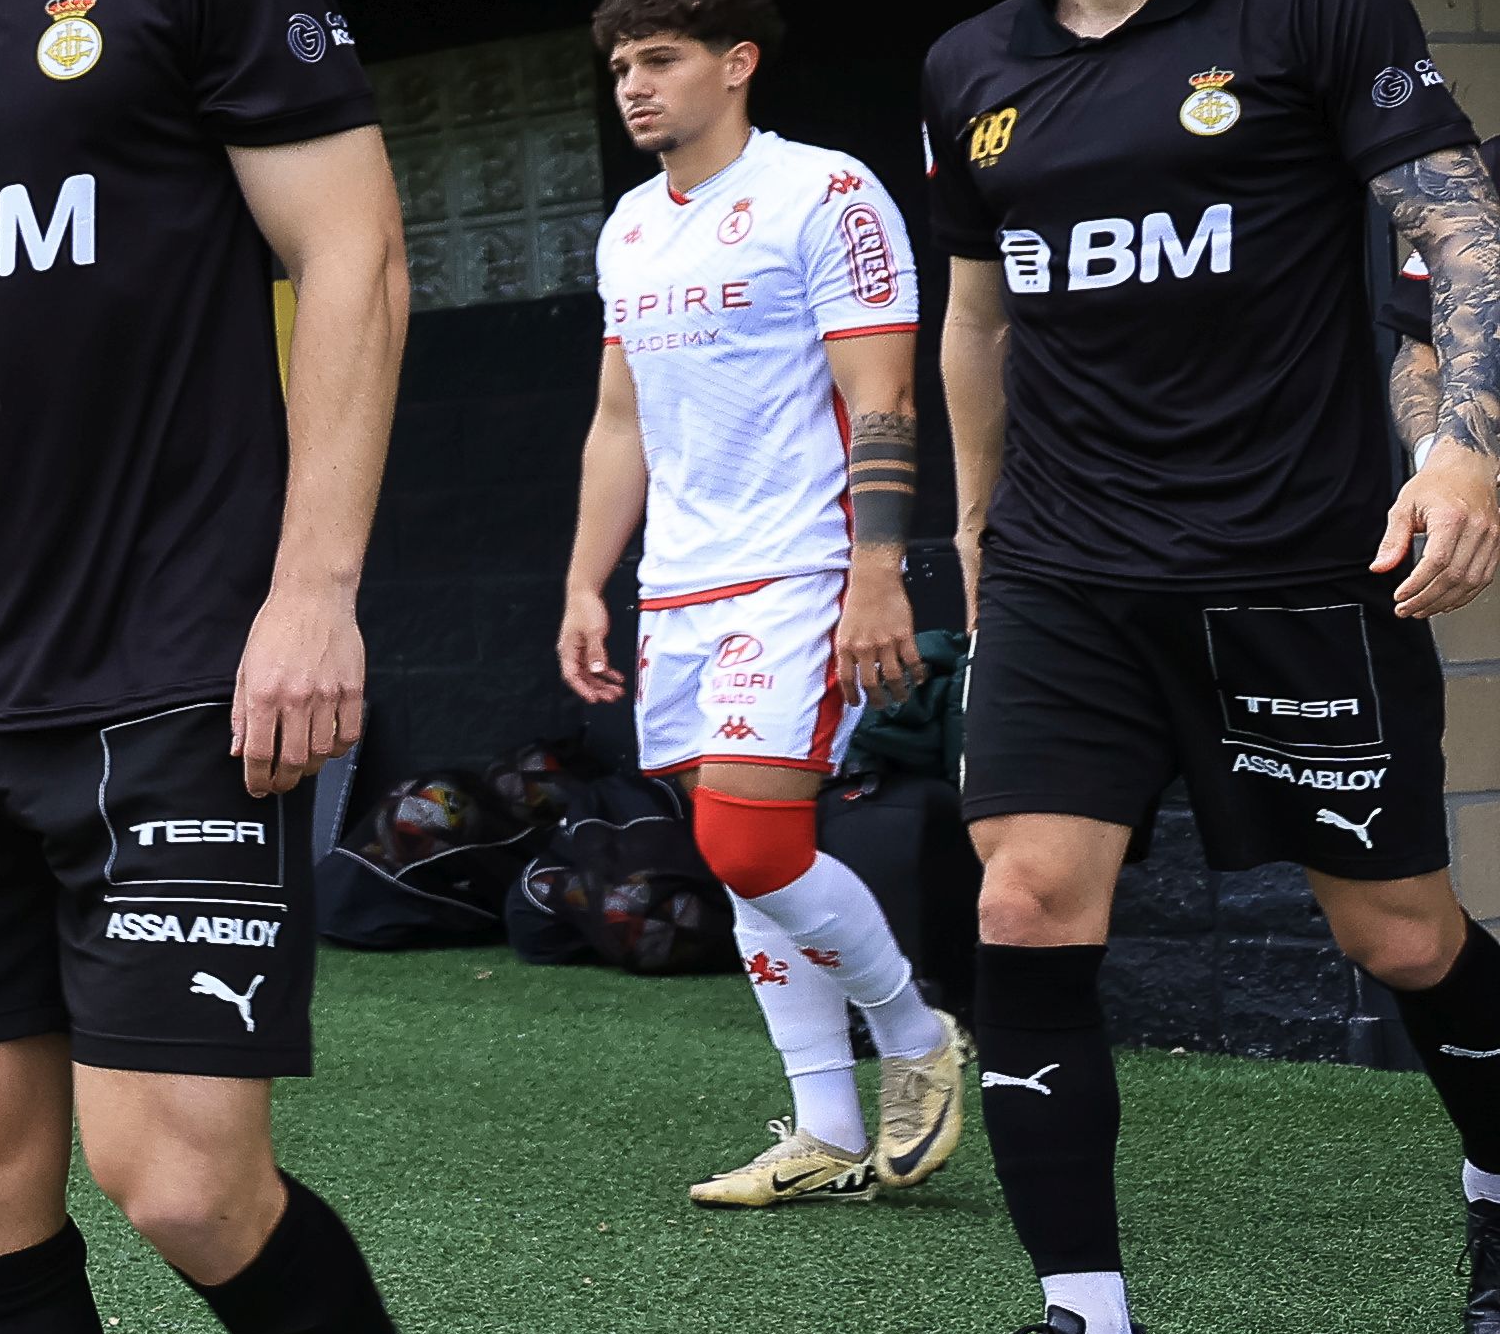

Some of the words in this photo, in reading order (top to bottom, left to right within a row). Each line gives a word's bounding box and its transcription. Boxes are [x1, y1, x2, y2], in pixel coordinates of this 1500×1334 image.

[1067, 203, 1233, 292] BM
[613, 281, 753, 323] SPIRE
[1234, 695, 1359, 718] TESA
[1231, 753, 1297, 783] ASSA
[1297, 767, 1388, 791] ABLOY
[128, 819, 266, 847] TESA
[105, 912, 186, 944] ASSA
[186, 916, 282, 948] ABLOY
